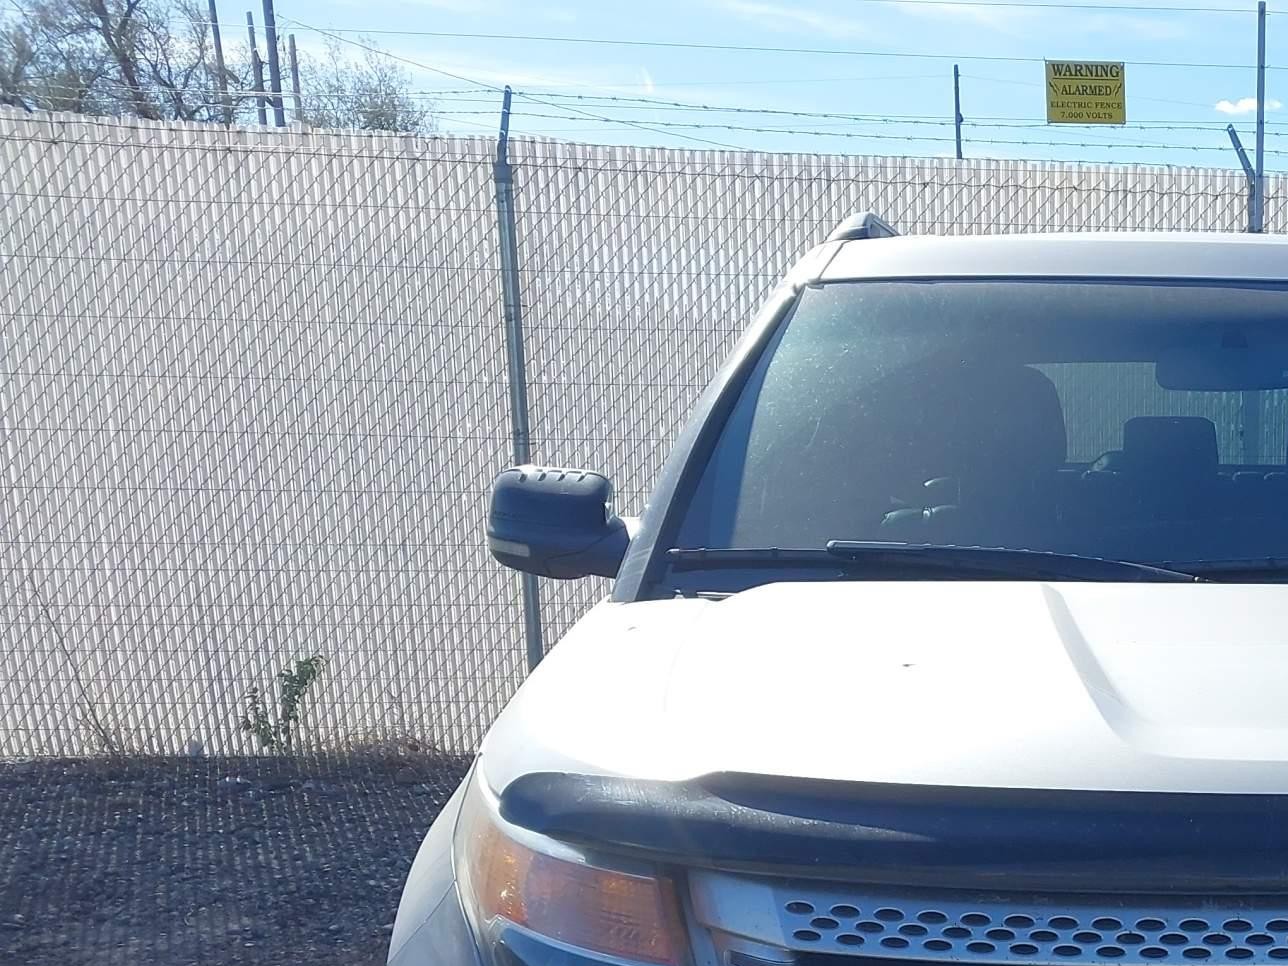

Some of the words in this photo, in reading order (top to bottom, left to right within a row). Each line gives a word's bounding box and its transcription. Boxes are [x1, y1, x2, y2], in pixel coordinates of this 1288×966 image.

[1051, 63, 1120, 78] WARNING
[1061, 85, 1111, 96] ALARMED
[1051, 101, 1092, 109] ELECTRIC
[1095, 102, 1122, 110] FENCE
